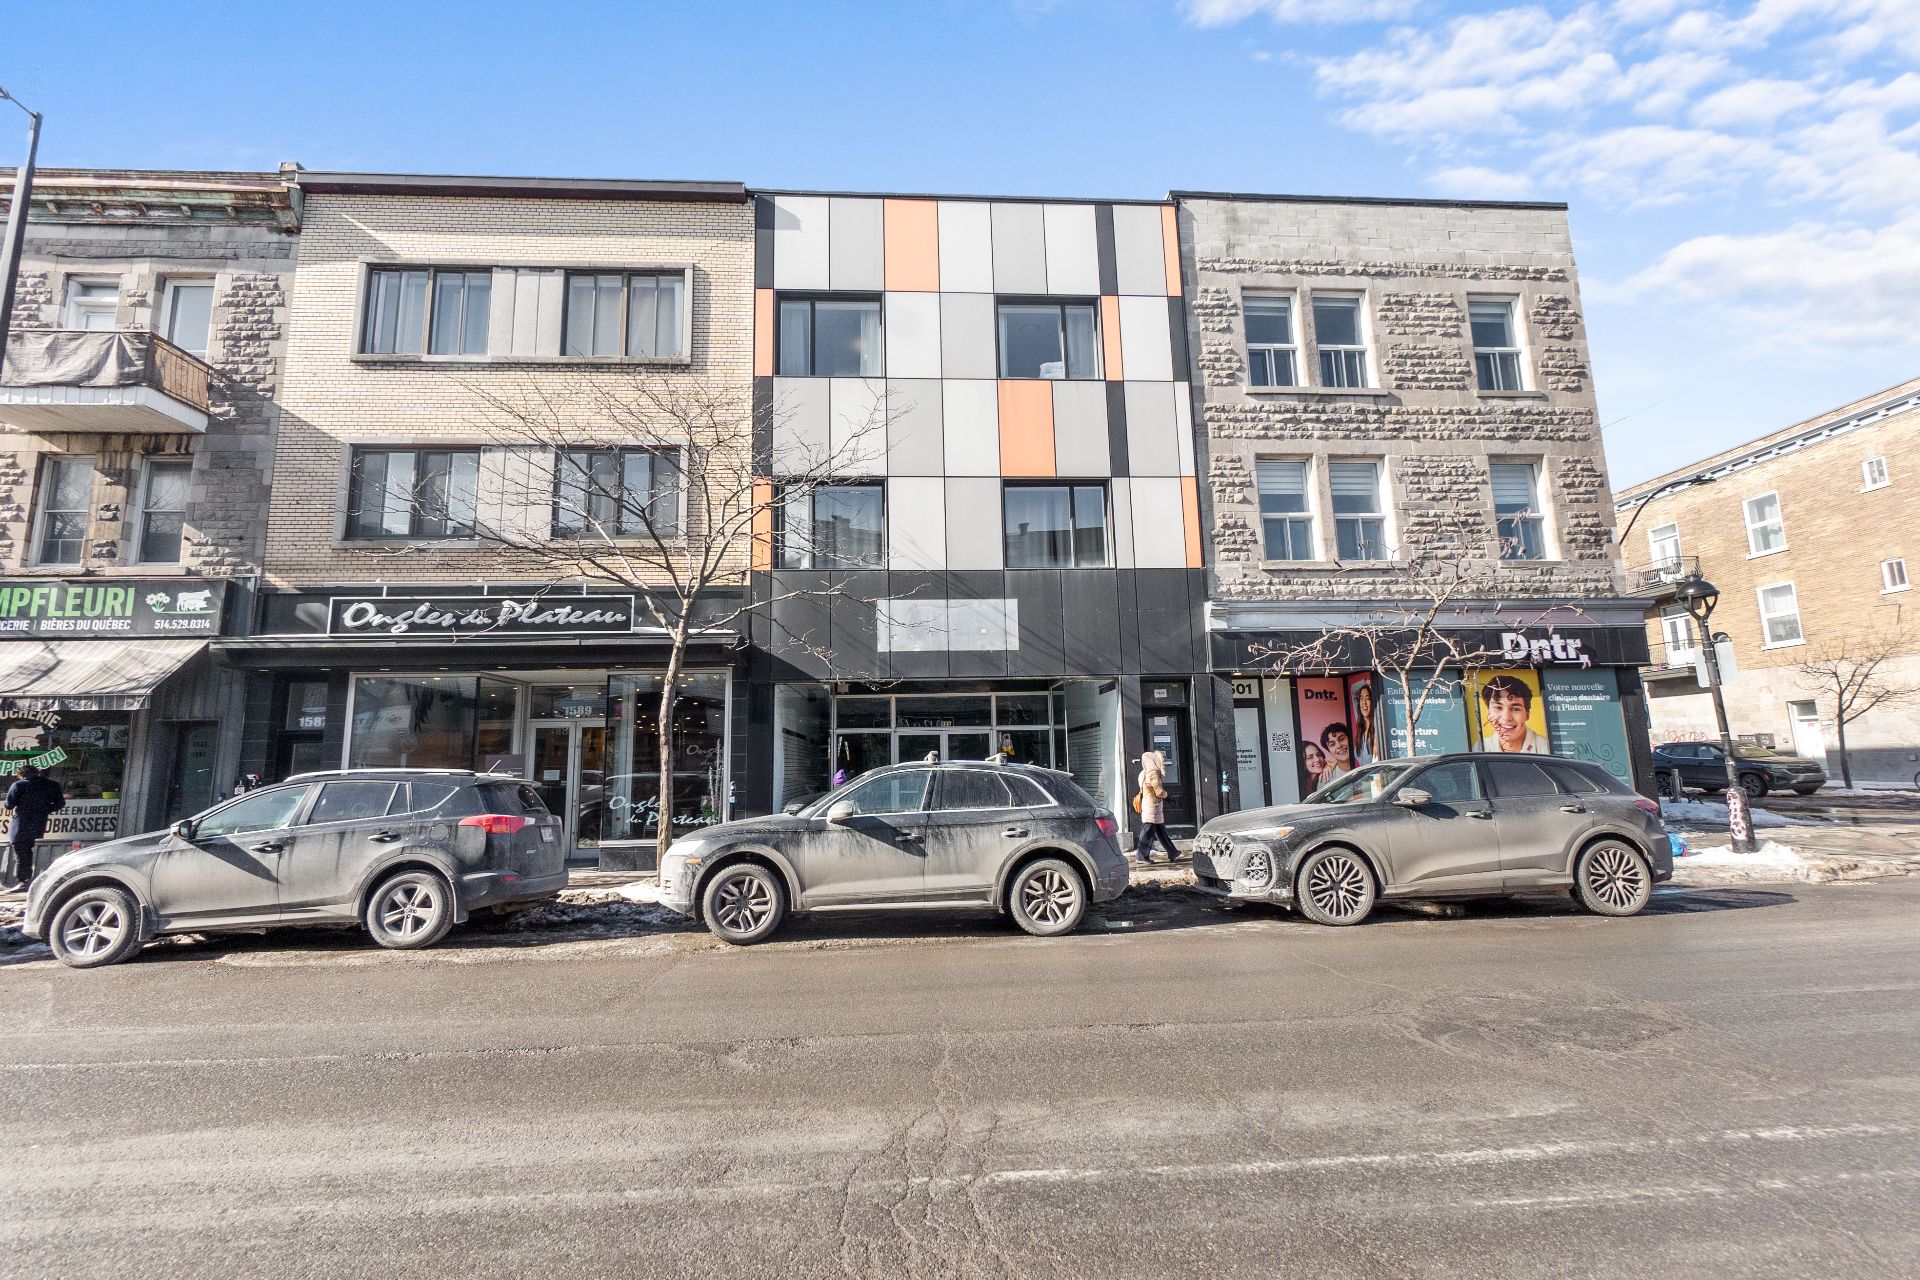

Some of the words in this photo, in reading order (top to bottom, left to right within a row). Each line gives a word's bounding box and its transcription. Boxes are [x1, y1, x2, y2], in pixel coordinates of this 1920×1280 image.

[343, 602, 456, 633] Ongles
[460, 609, 493, 625] du
[498, 600, 627, 627] Plateau
[40, 617, 76, 631] BIÈRES
[76, 619, 91, 631] DU
[91, 617, 132, 631] QUÉBEC
[154, 619, 211, 630] 514.529.0314
[1501, 632, 1590, 663] Dntr.
[1387, 687, 1404, 695] Enfi
[1547, 683, 1570, 691] Votre
[1571, 683, 1605, 691] nouvelle
[1304, 688, 1338, 701] Dntr.
[1548, 693, 1578, 702] clinique
[1578, 693, 1611, 701] dentaire
[1415, 697, 1446, 705] dntiste
[564, 705, 593, 716] 1589
[1561, 703, 1593, 711] Plateau
[1390, 727, 1439, 736] Ouvrture
[608, 796, 661, 813] Ongle
[626, 814, 643, 824] du
